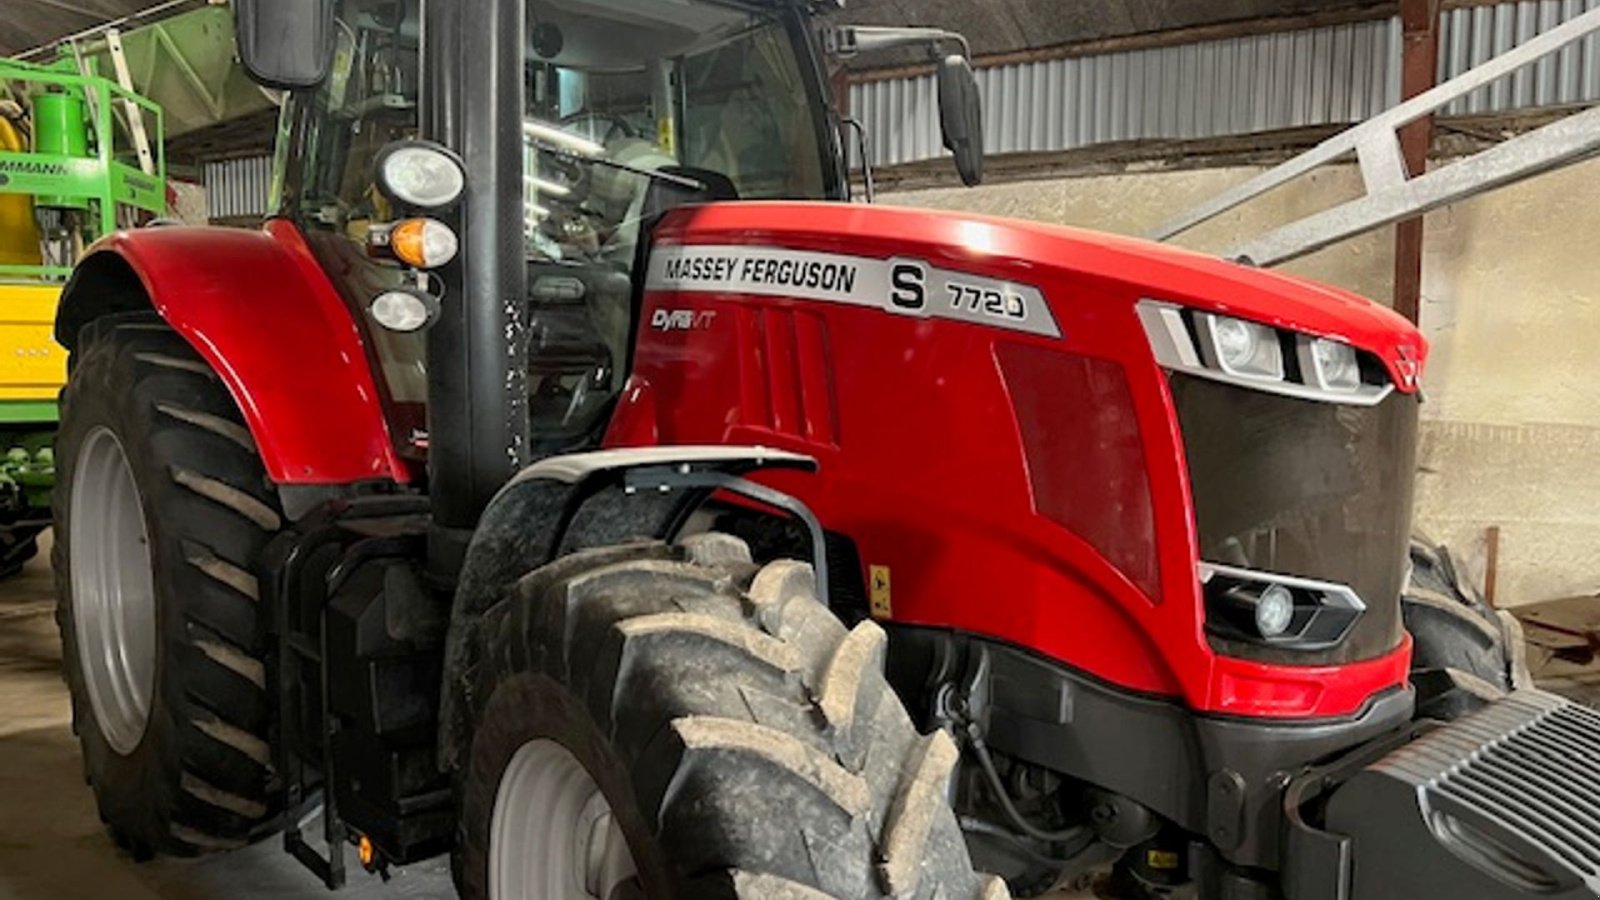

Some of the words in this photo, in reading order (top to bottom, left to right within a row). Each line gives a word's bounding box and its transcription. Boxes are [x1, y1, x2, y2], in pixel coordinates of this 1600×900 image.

[665, 257, 738, 280] MASSEY
[740, 259, 856, 293] FERGUSON
[891, 264, 924, 309] S
[947, 284, 1024, 318] 7720
